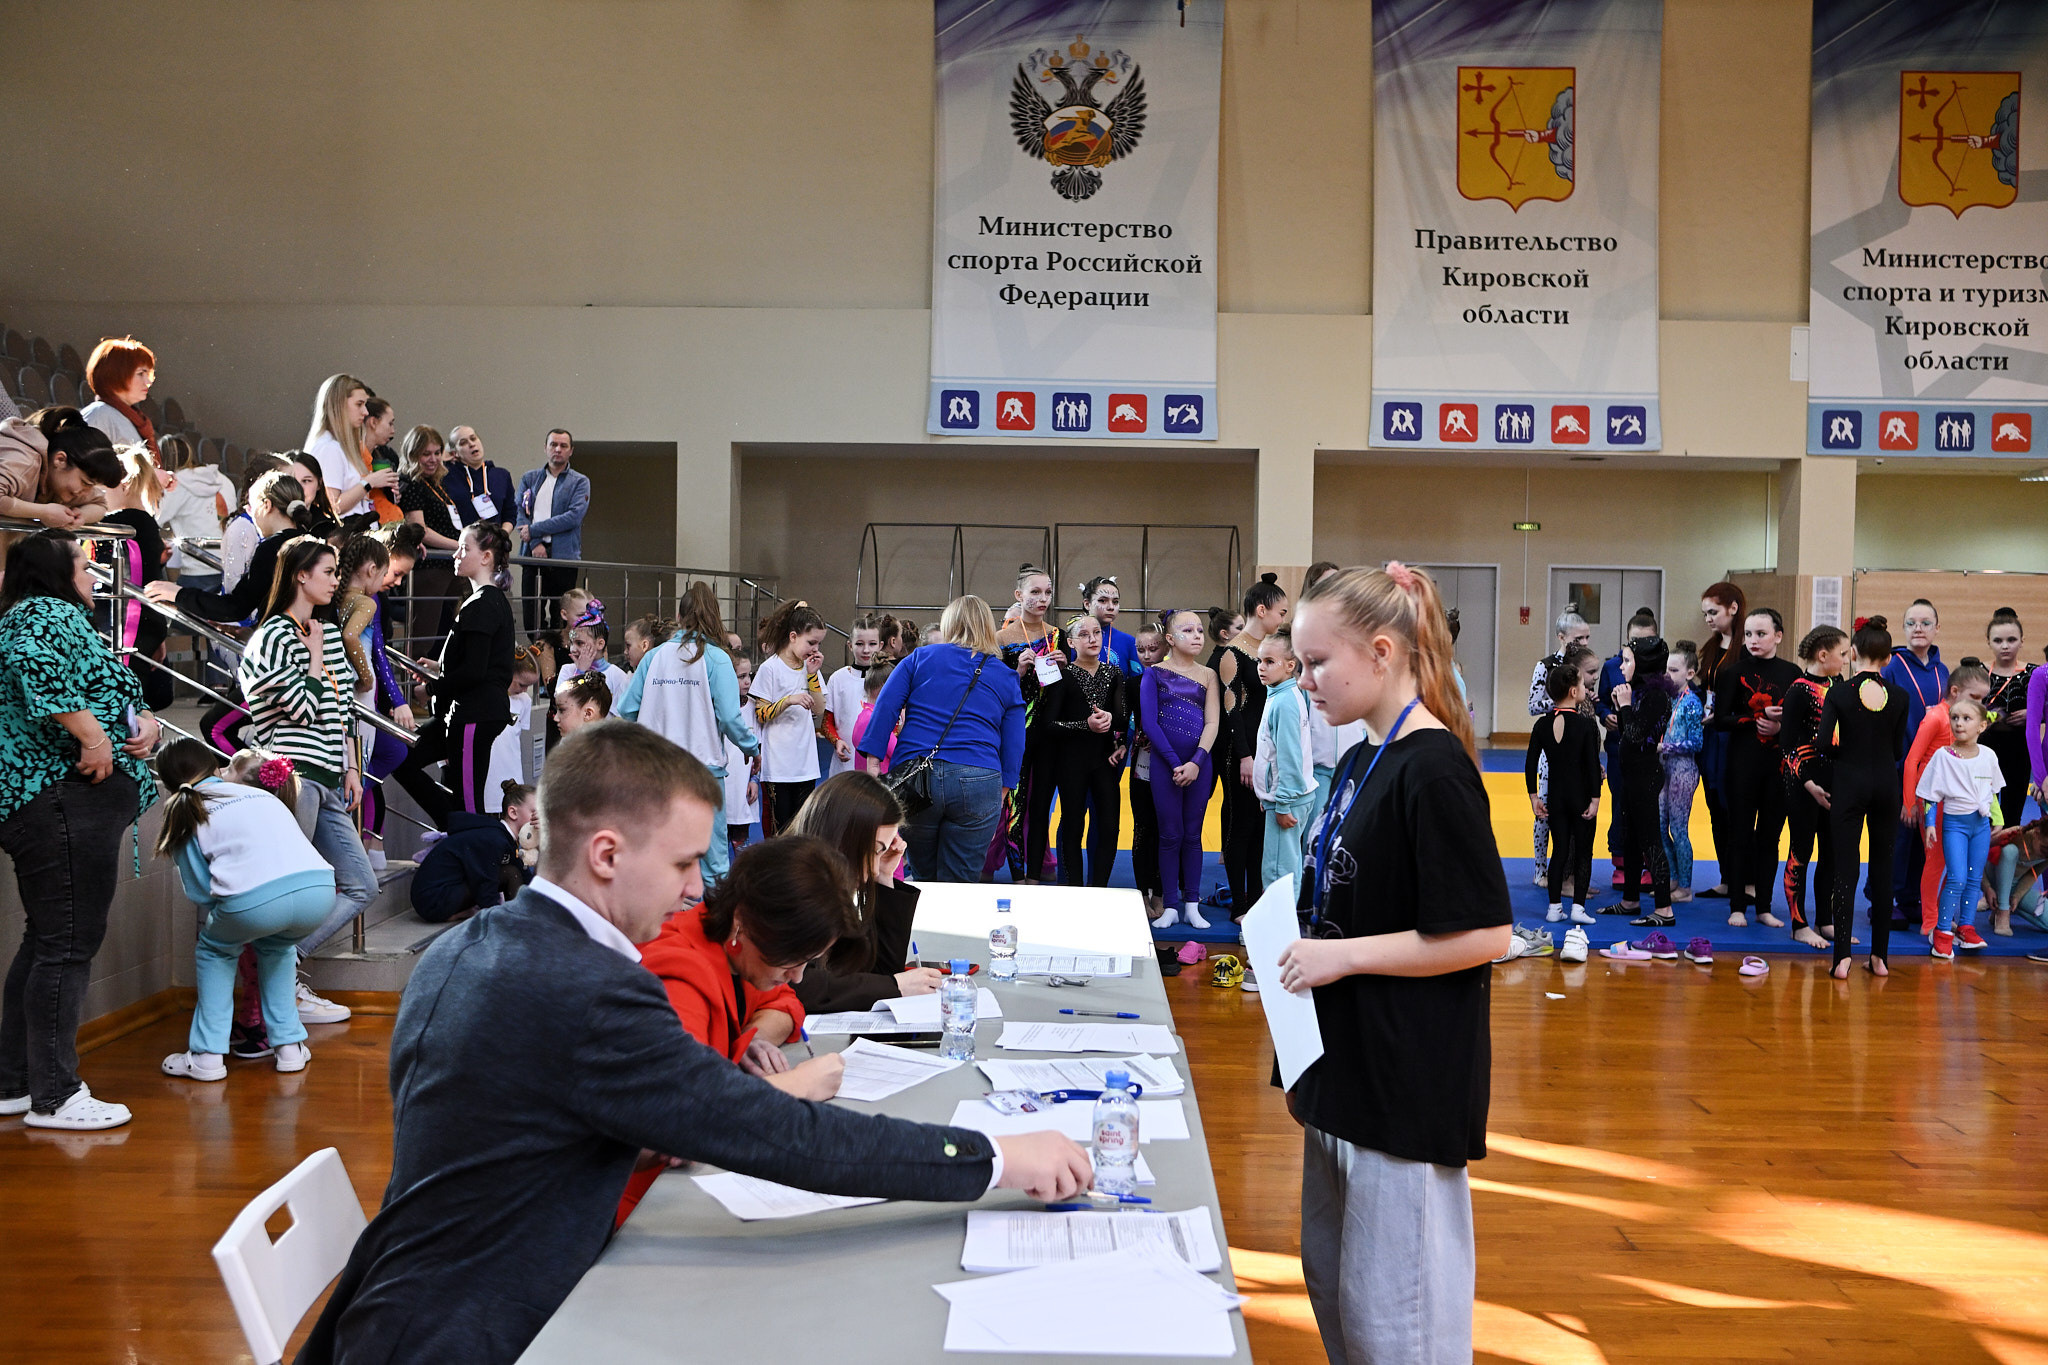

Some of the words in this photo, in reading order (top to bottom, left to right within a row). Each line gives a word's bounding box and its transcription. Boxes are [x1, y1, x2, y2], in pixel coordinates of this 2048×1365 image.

[978, 215, 1173, 242] Министерство
[1414, 228, 1618, 254] Правительство
[947, 253, 1039, 275] спорта
[1046, 251, 1203, 274] Российской
[1442, 266, 1590, 292] Кировской
[999, 283, 1150, 311] Федерации
[1843, 285, 1932, 306] спорта
[1939, 288, 1955, 302] и
[1462, 304, 1569, 325] области
[1884, 315, 2030, 340] Кировской
[1904, 350, 2009, 371] области
